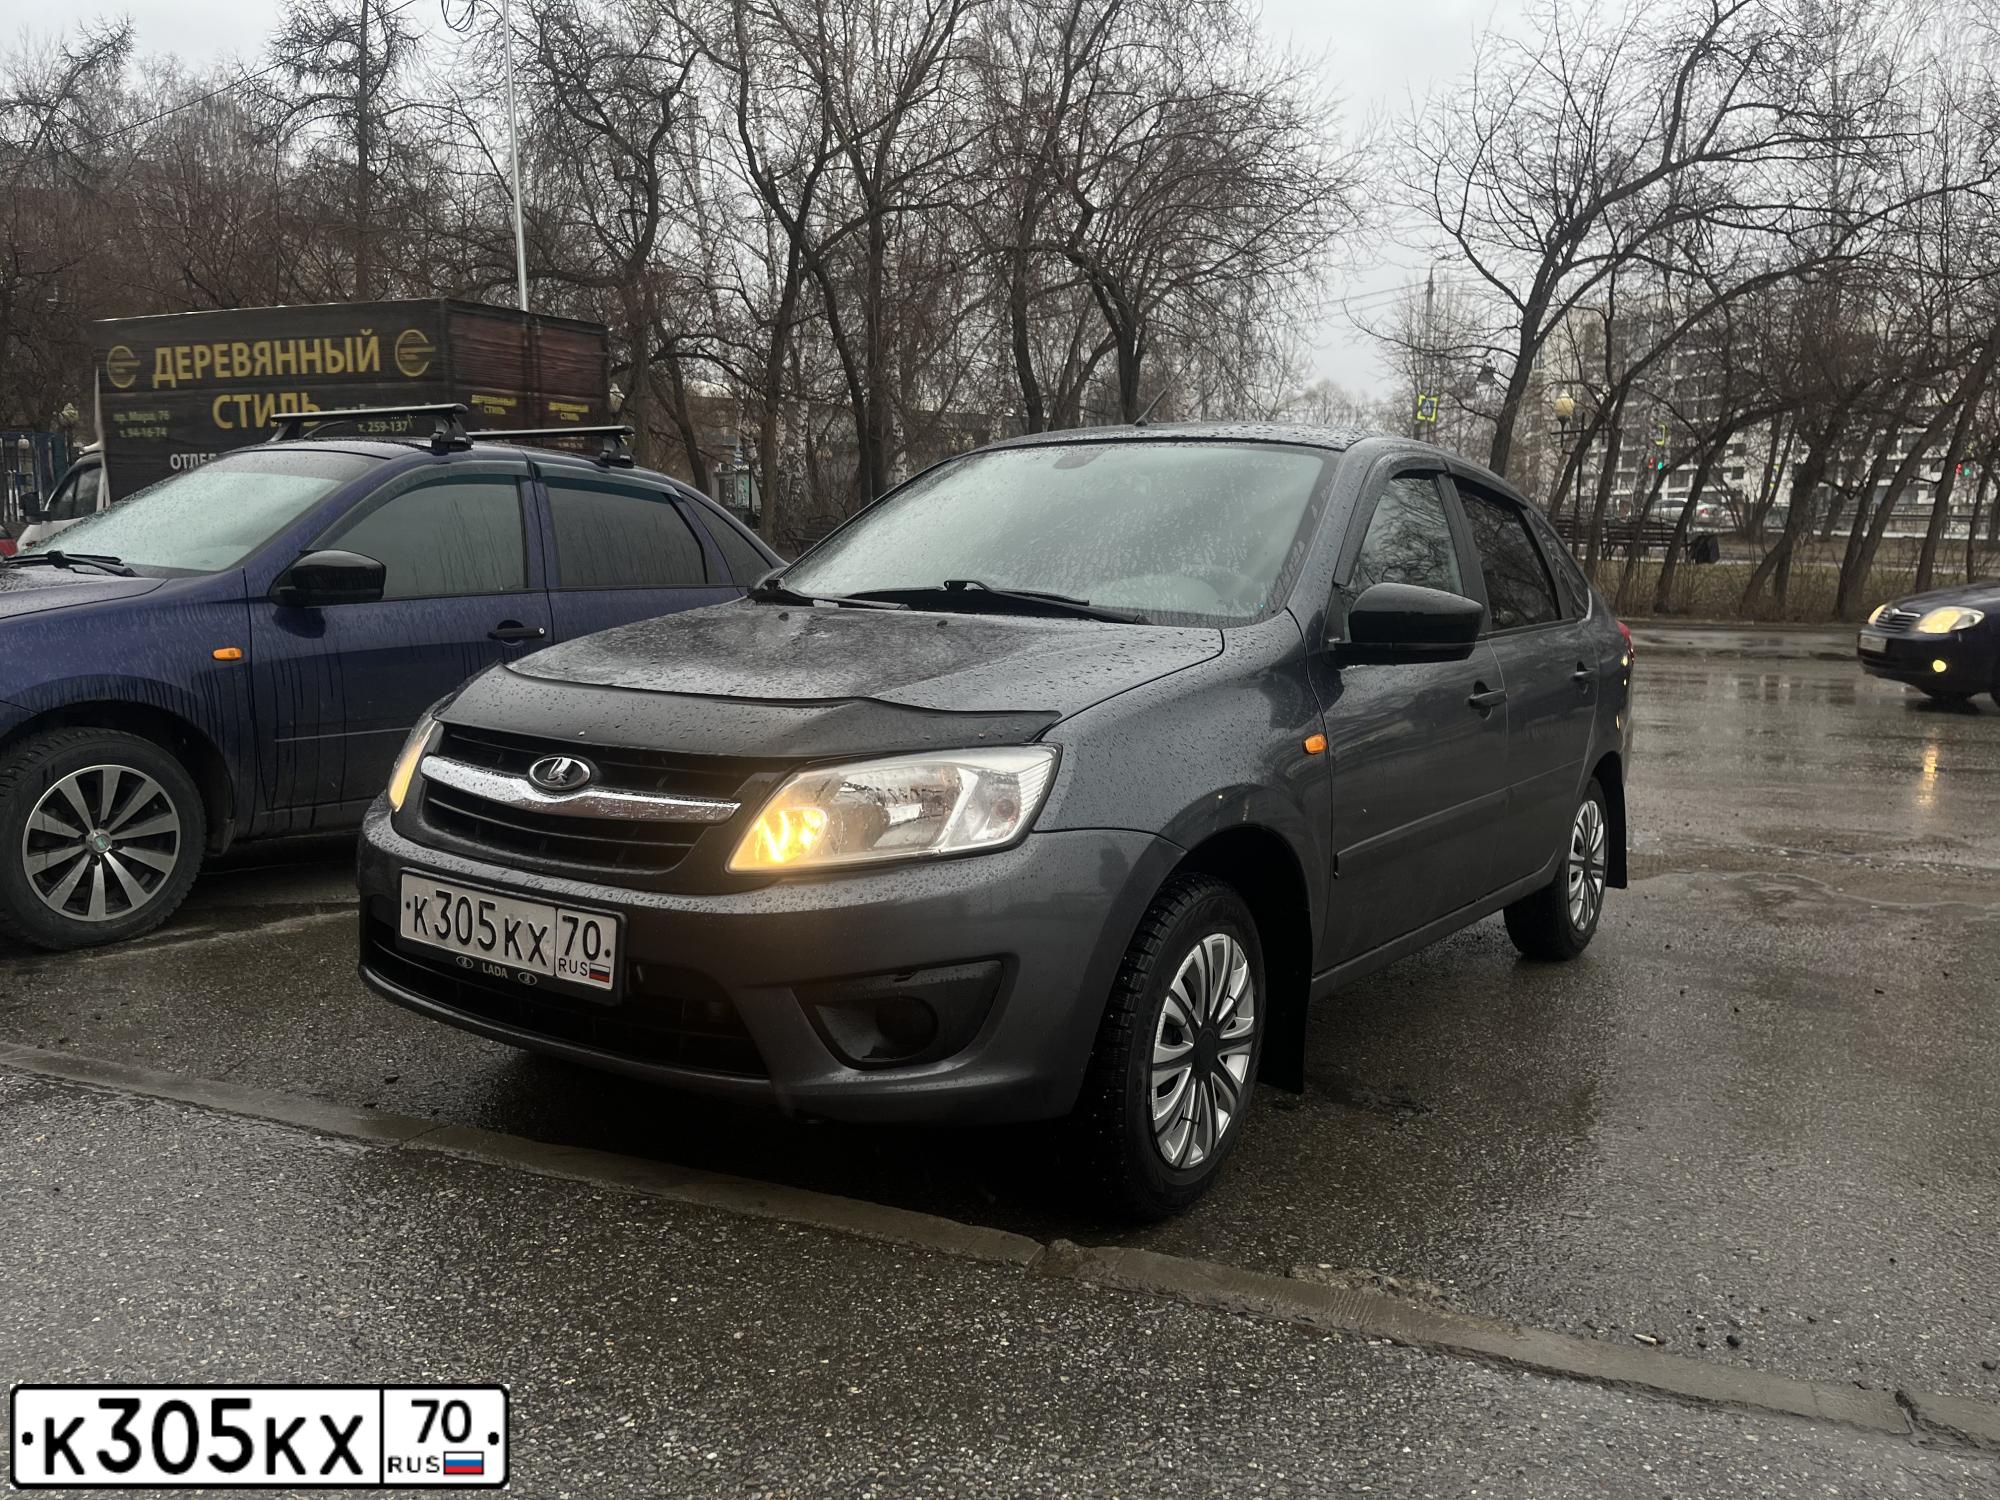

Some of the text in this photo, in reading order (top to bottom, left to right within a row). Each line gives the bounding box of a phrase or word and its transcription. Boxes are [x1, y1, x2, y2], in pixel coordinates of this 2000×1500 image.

[153, 329, 381, 388] ДЕРЕВЯННЫЙ
[212, 392, 320, 429] СТИЛЬ
[414, 889, 601, 968] К305КХ 70
[482, 963, 508, 980] LADA
[558, 957, 588, 976] RUS
